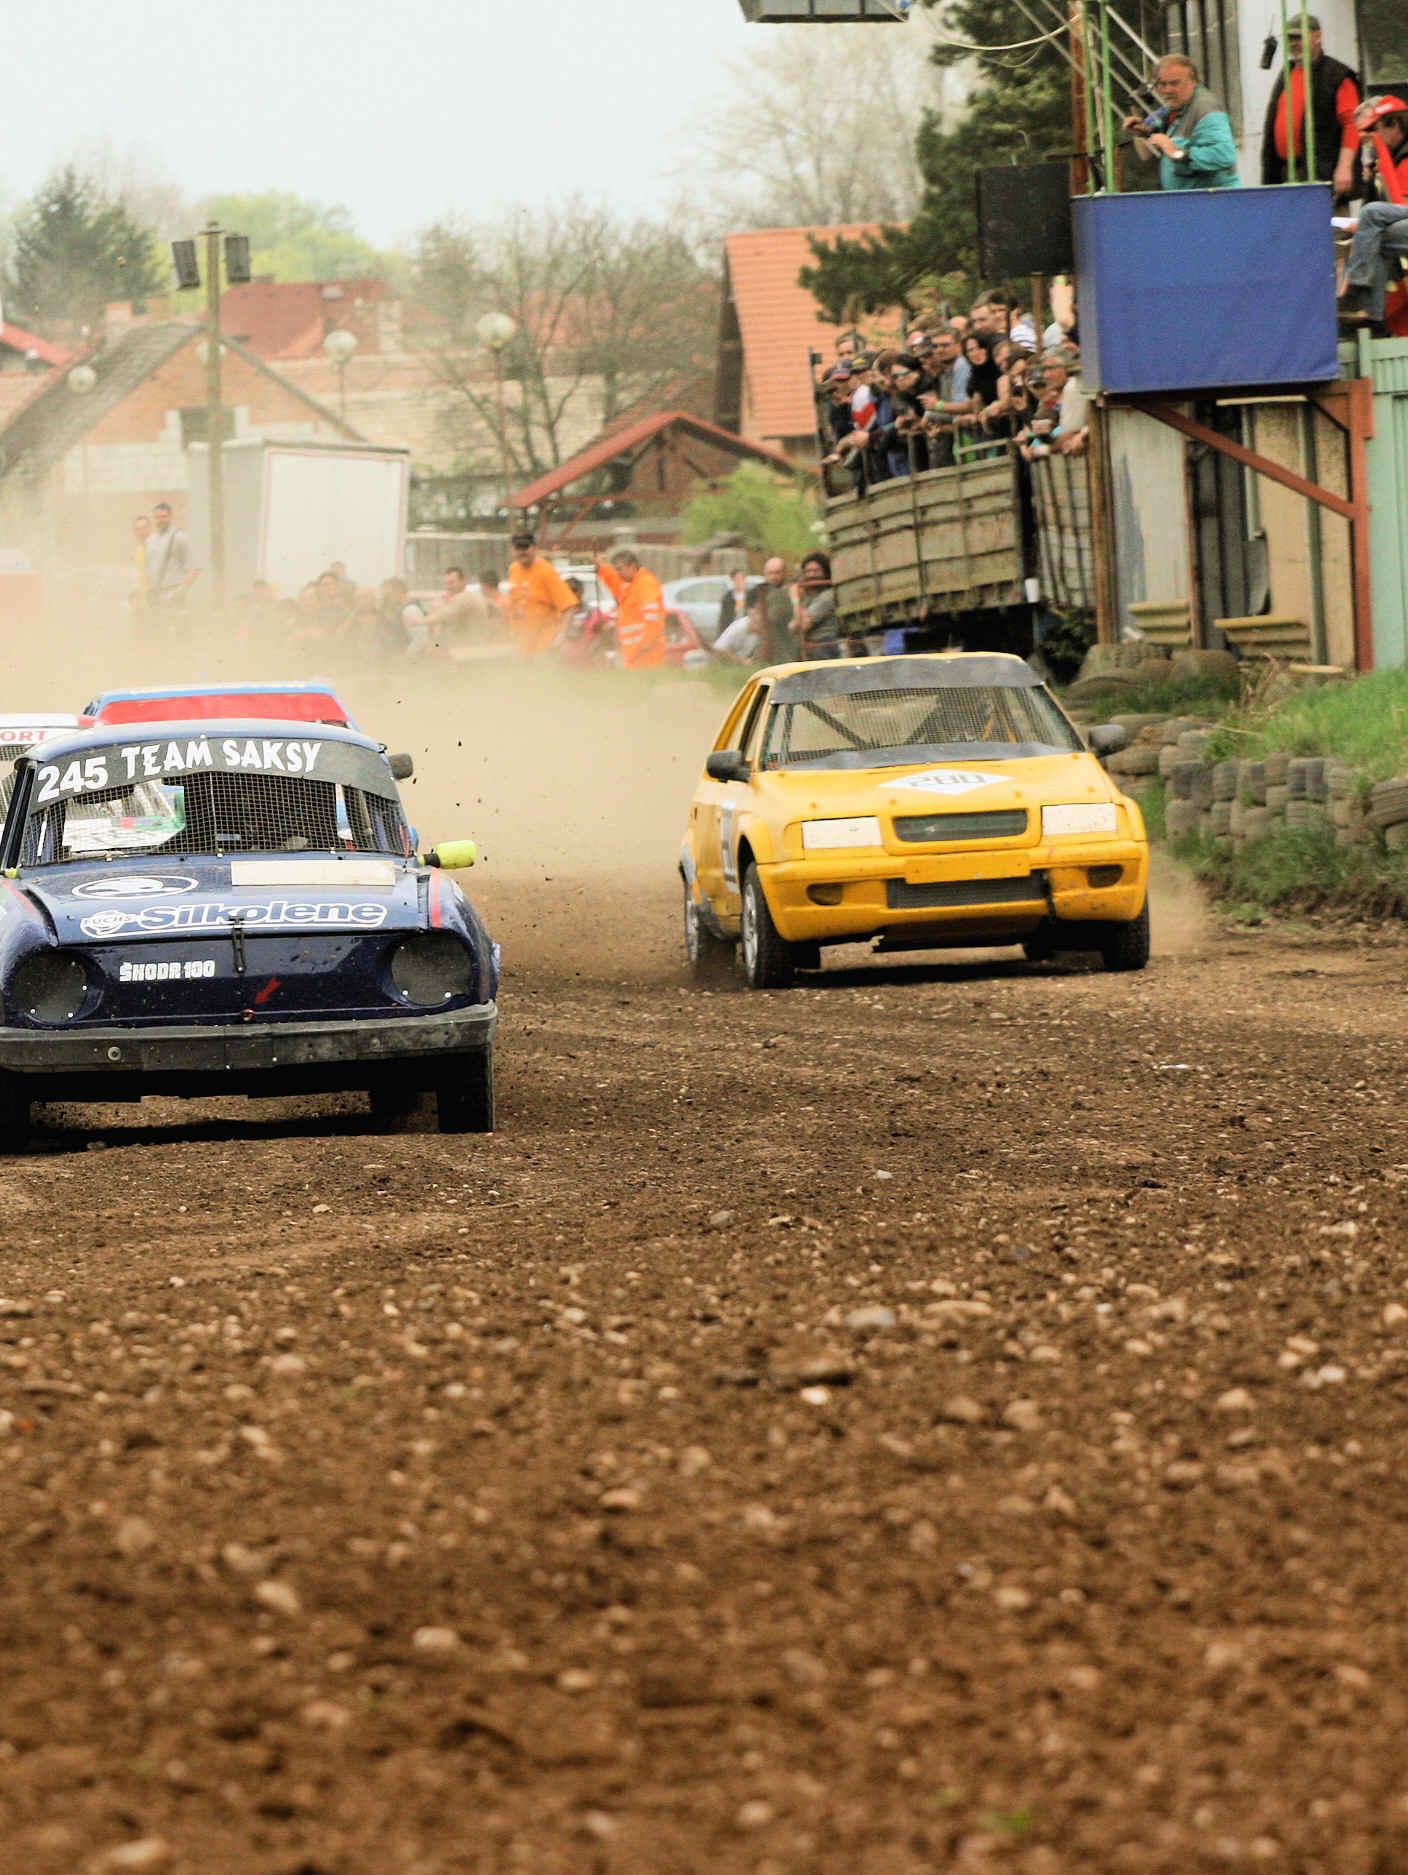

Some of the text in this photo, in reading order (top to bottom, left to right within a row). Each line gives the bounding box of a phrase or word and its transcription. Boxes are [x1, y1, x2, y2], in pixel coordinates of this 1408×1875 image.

[37, 739, 323, 803] 245 TEAM SAKSY
[138, 900, 388, 930] Silkolene
[184, 959, 216, 979] 100
